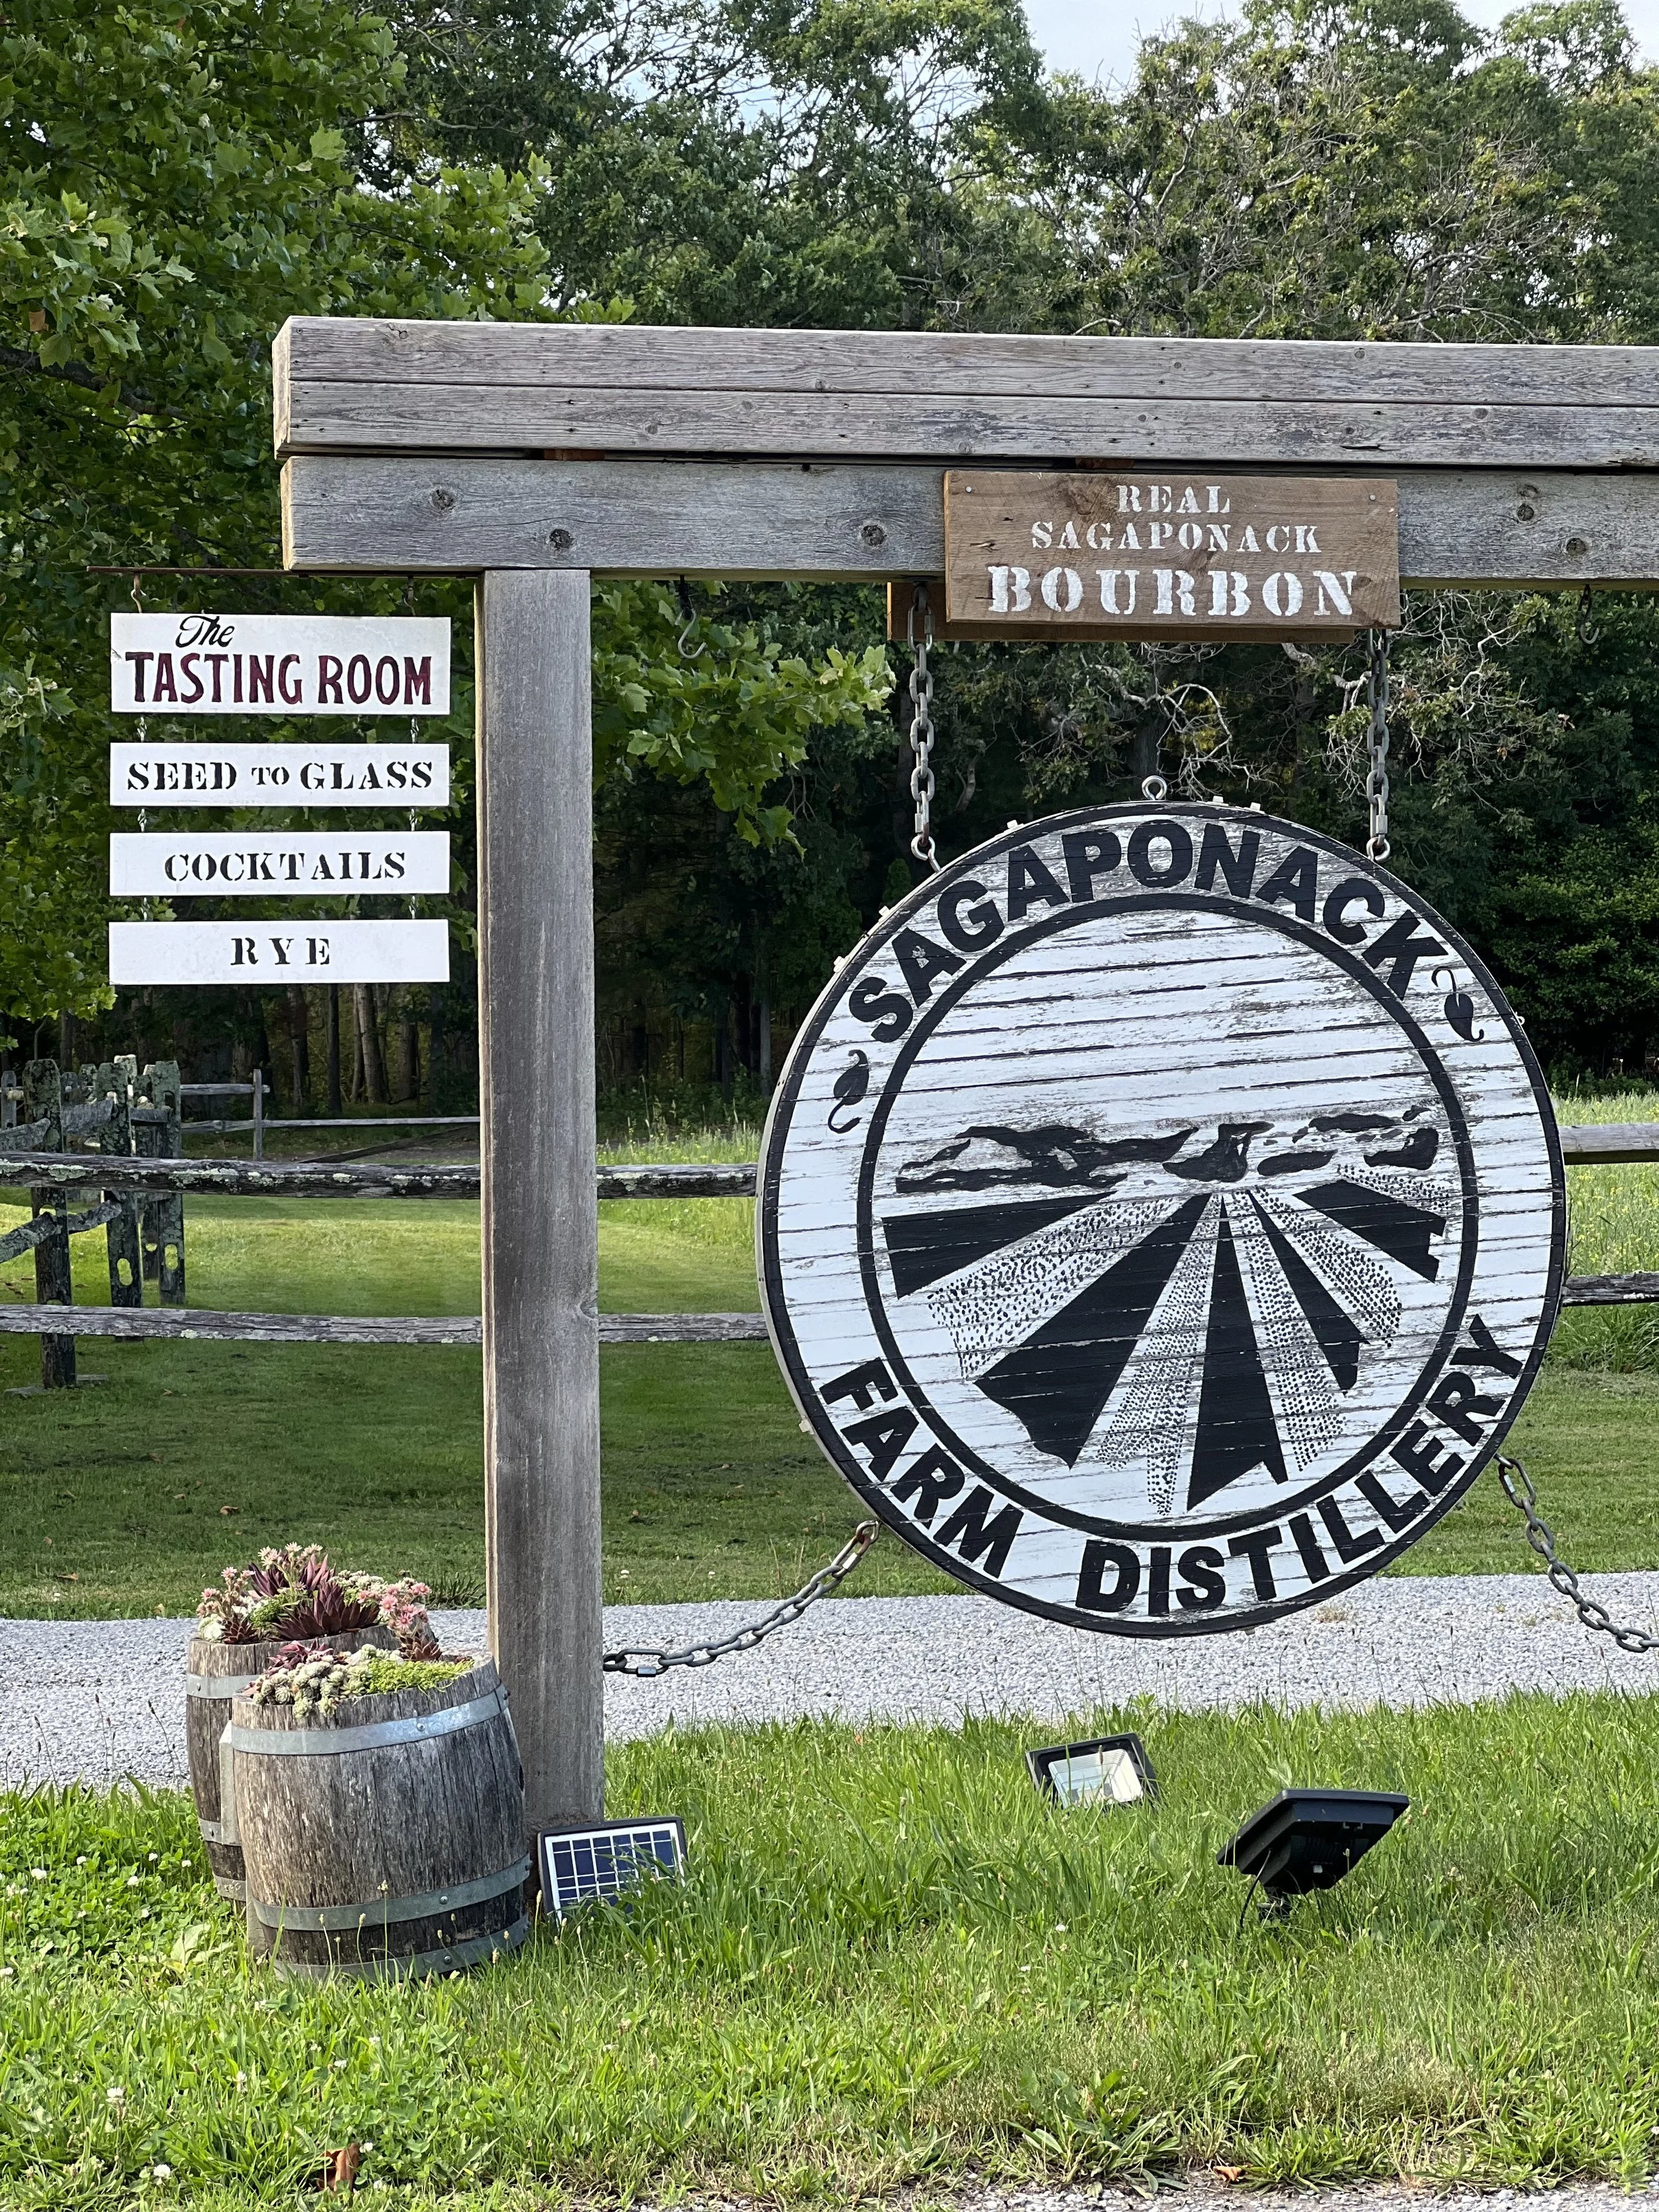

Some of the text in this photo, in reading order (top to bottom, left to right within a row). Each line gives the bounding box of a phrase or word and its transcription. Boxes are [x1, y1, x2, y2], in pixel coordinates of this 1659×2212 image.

[1116, 484, 1231, 514] REAL
[1031, 521, 1323, 553] SAGAPONACK
[987, 565, 1358, 617] BOURBON
[175, 615, 235, 648] The
[125, 651, 433, 705] TASTING ROOM
[127, 761, 433, 790] SEED TO GLASS
[163, 851, 406, 881] COCKTAILS
[848, 820, 1449, 1044] SAGAPONACK
[230, 937, 330, 966] RYE
[818, 1313, 1524, 1617] FARM DISTILLERY
